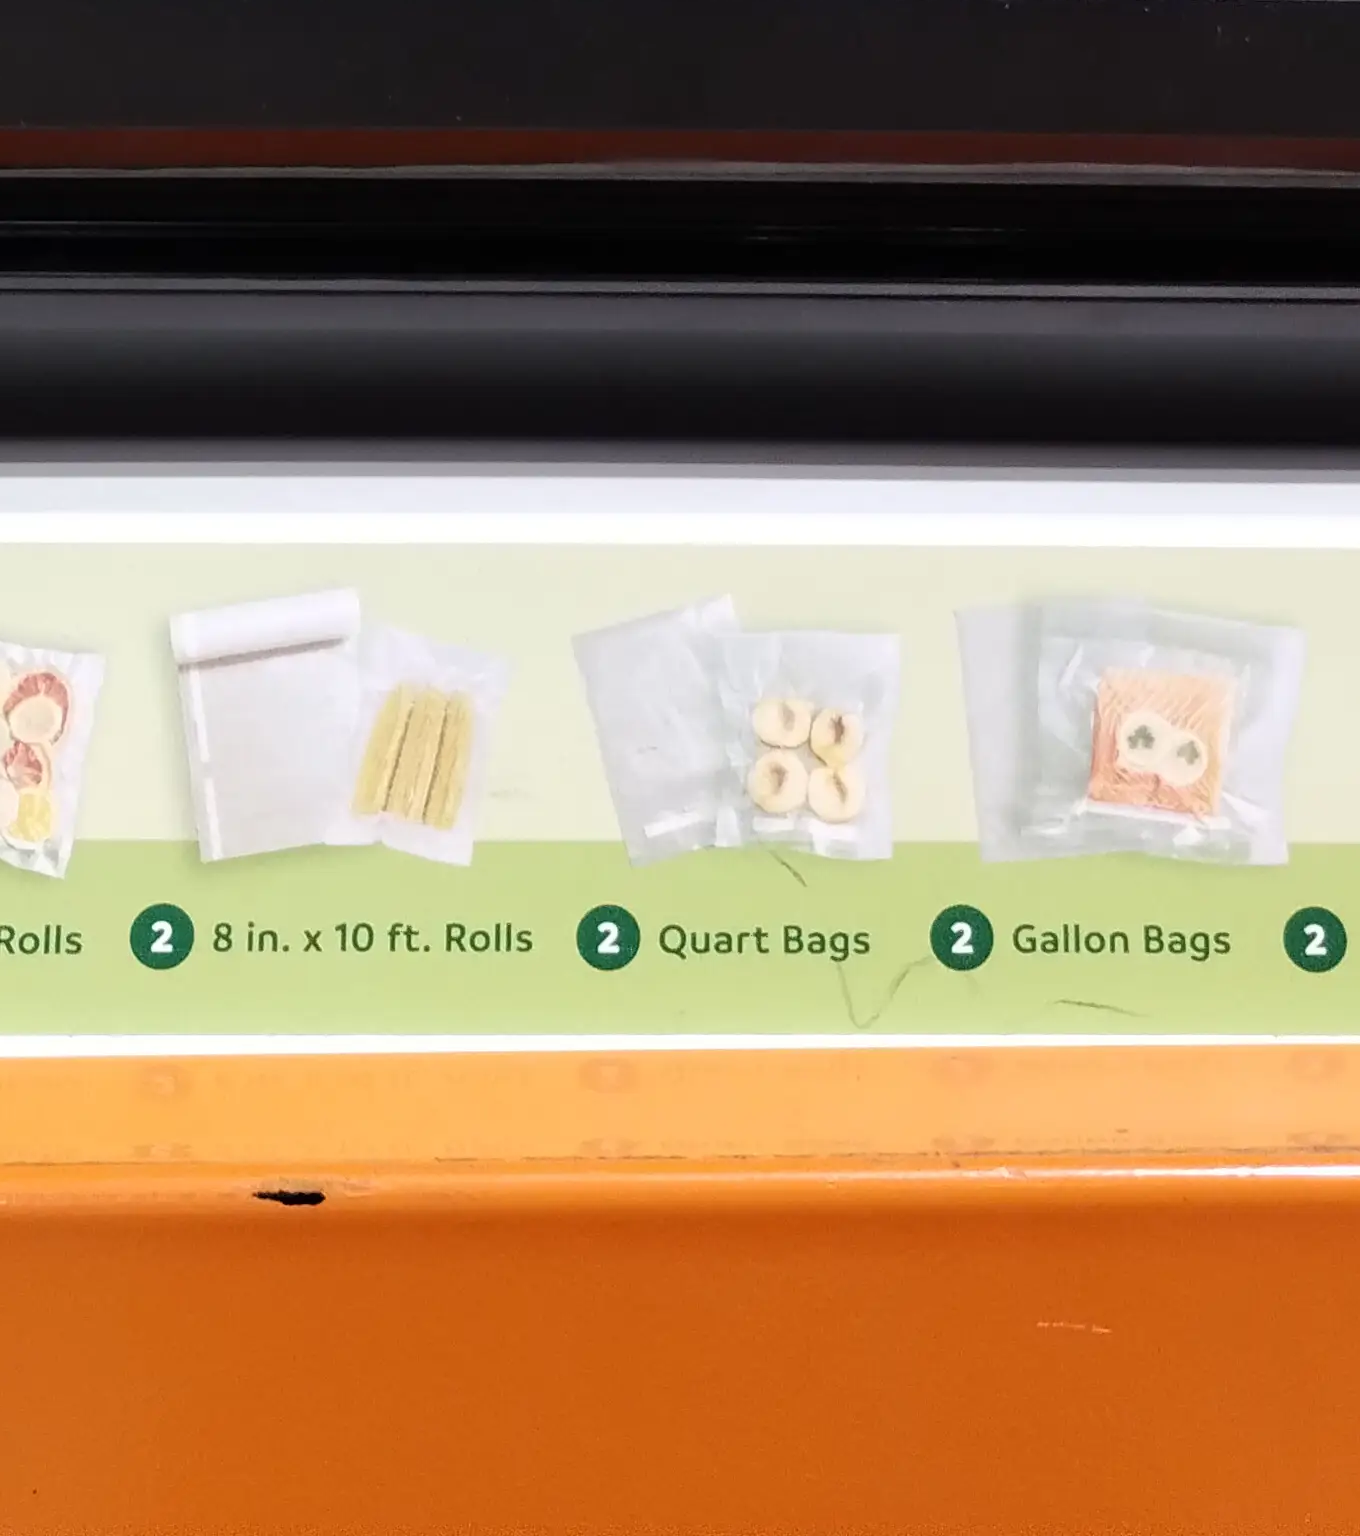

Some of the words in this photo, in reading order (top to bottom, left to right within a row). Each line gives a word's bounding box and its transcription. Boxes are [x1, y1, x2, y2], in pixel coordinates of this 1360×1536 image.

[149, 920, 175, 954] 2
[211, 921, 235, 954] 8
[246, 920, 292, 954] in.
[302, 930, 324, 953] x
[334, 921, 376, 953] 10
[386, 920, 432, 954] ft.
[443, 921, 535, 954] Rolls
[596, 920, 622, 955] 2
[658, 923, 771, 961] Quart
[781, 924, 872, 963] Bags
[949, 920, 975, 955] 2
[1011, 923, 1131, 956] Gallon
[1142, 923, 1233, 962] Bags
[1302, 922, 1329, 957] 2
